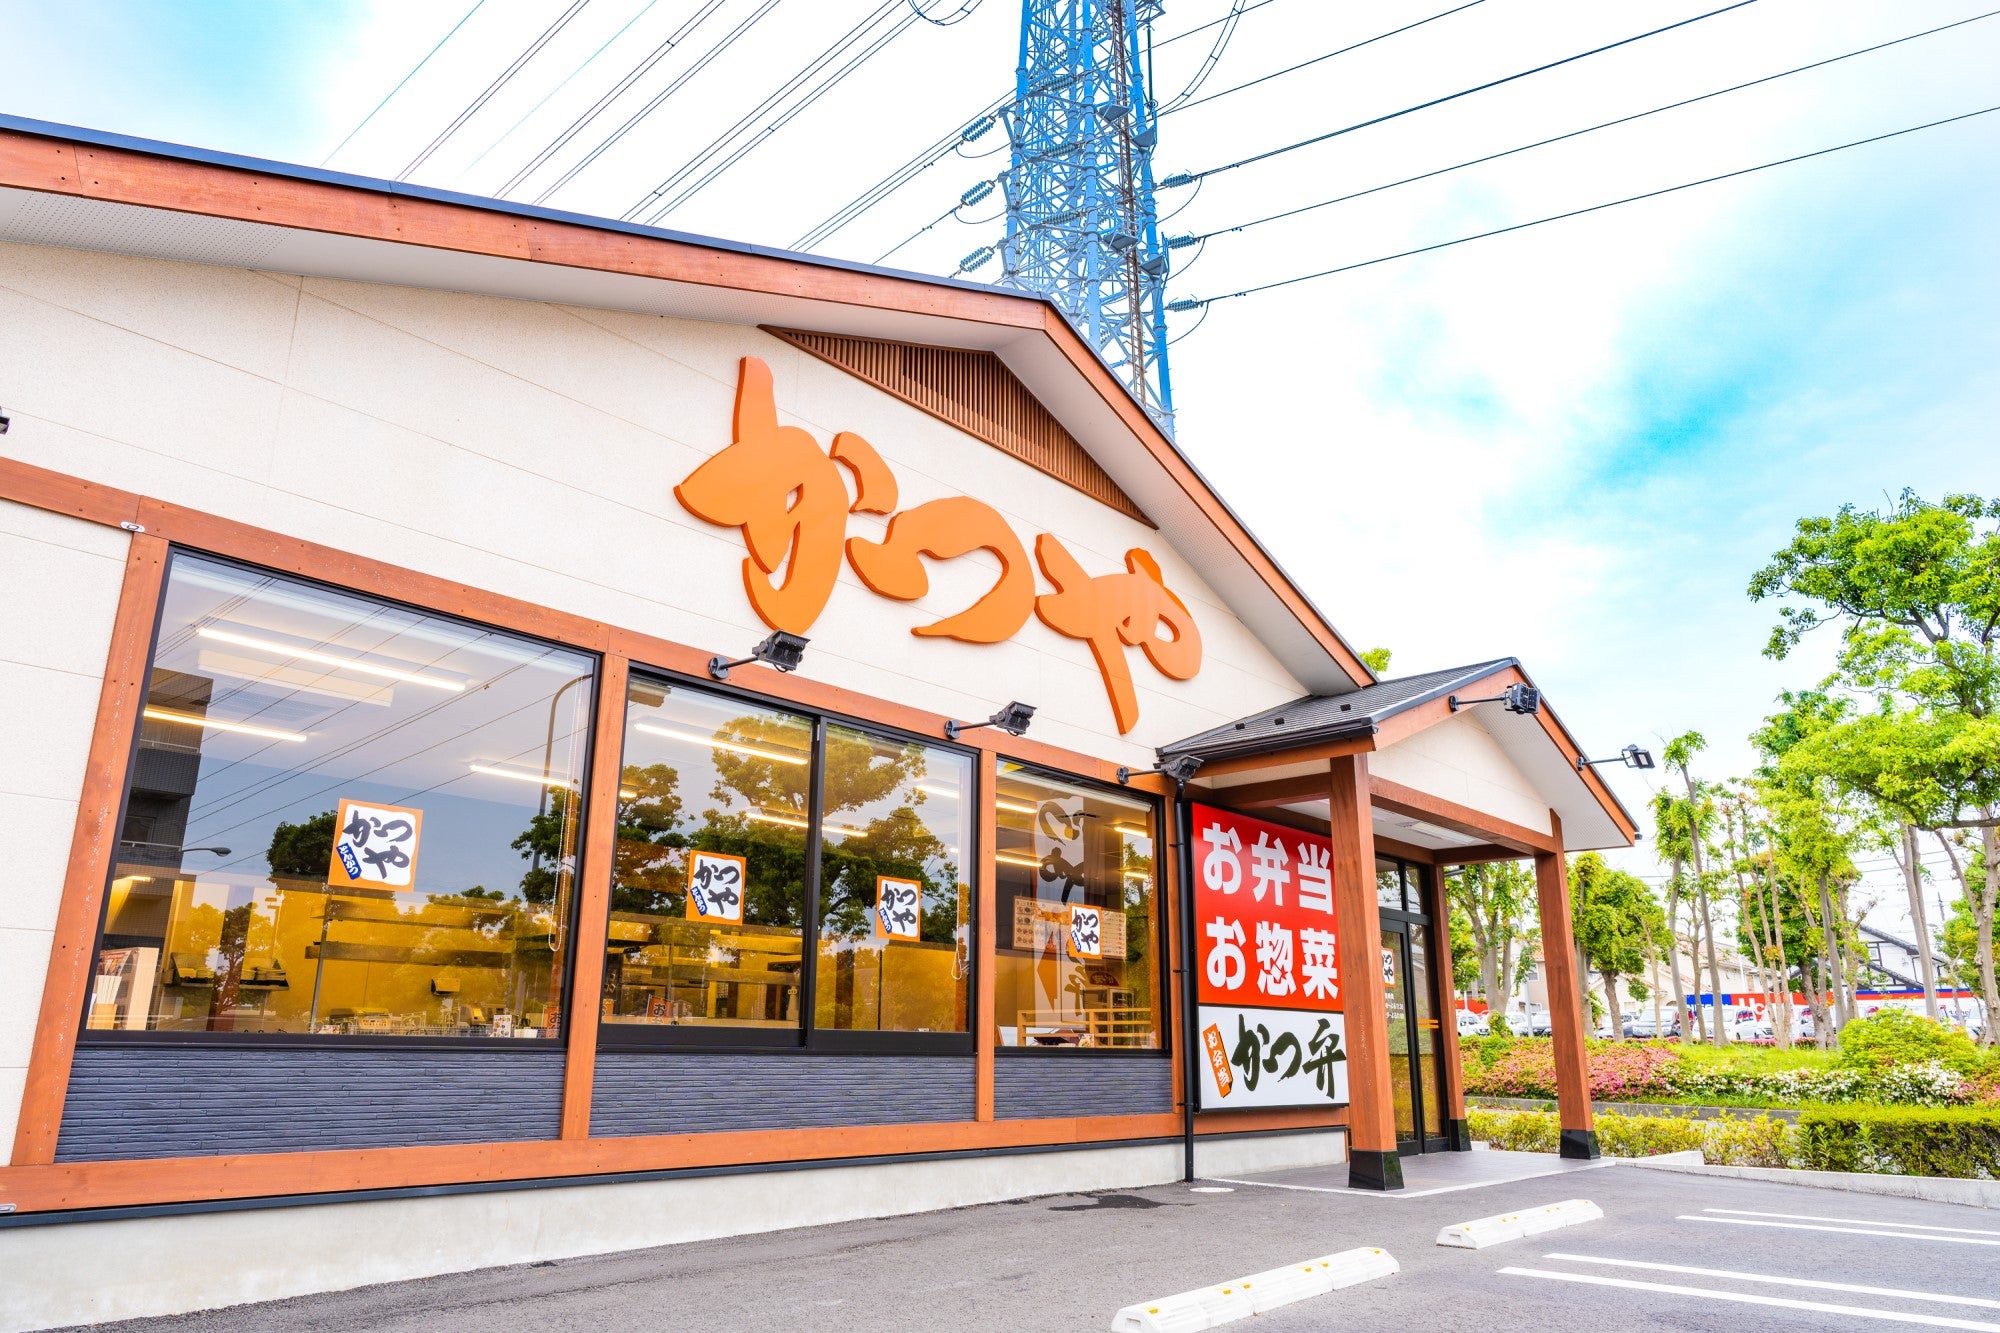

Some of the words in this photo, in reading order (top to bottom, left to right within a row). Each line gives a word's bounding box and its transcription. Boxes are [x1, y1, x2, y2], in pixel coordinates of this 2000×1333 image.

[674, 356, 1202, 735] かつや
[1203, 822, 1333, 915] お弁当
[1206, 916, 1339, 999] お惣菜
[1231, 1013, 1347, 1099] かつ弁
